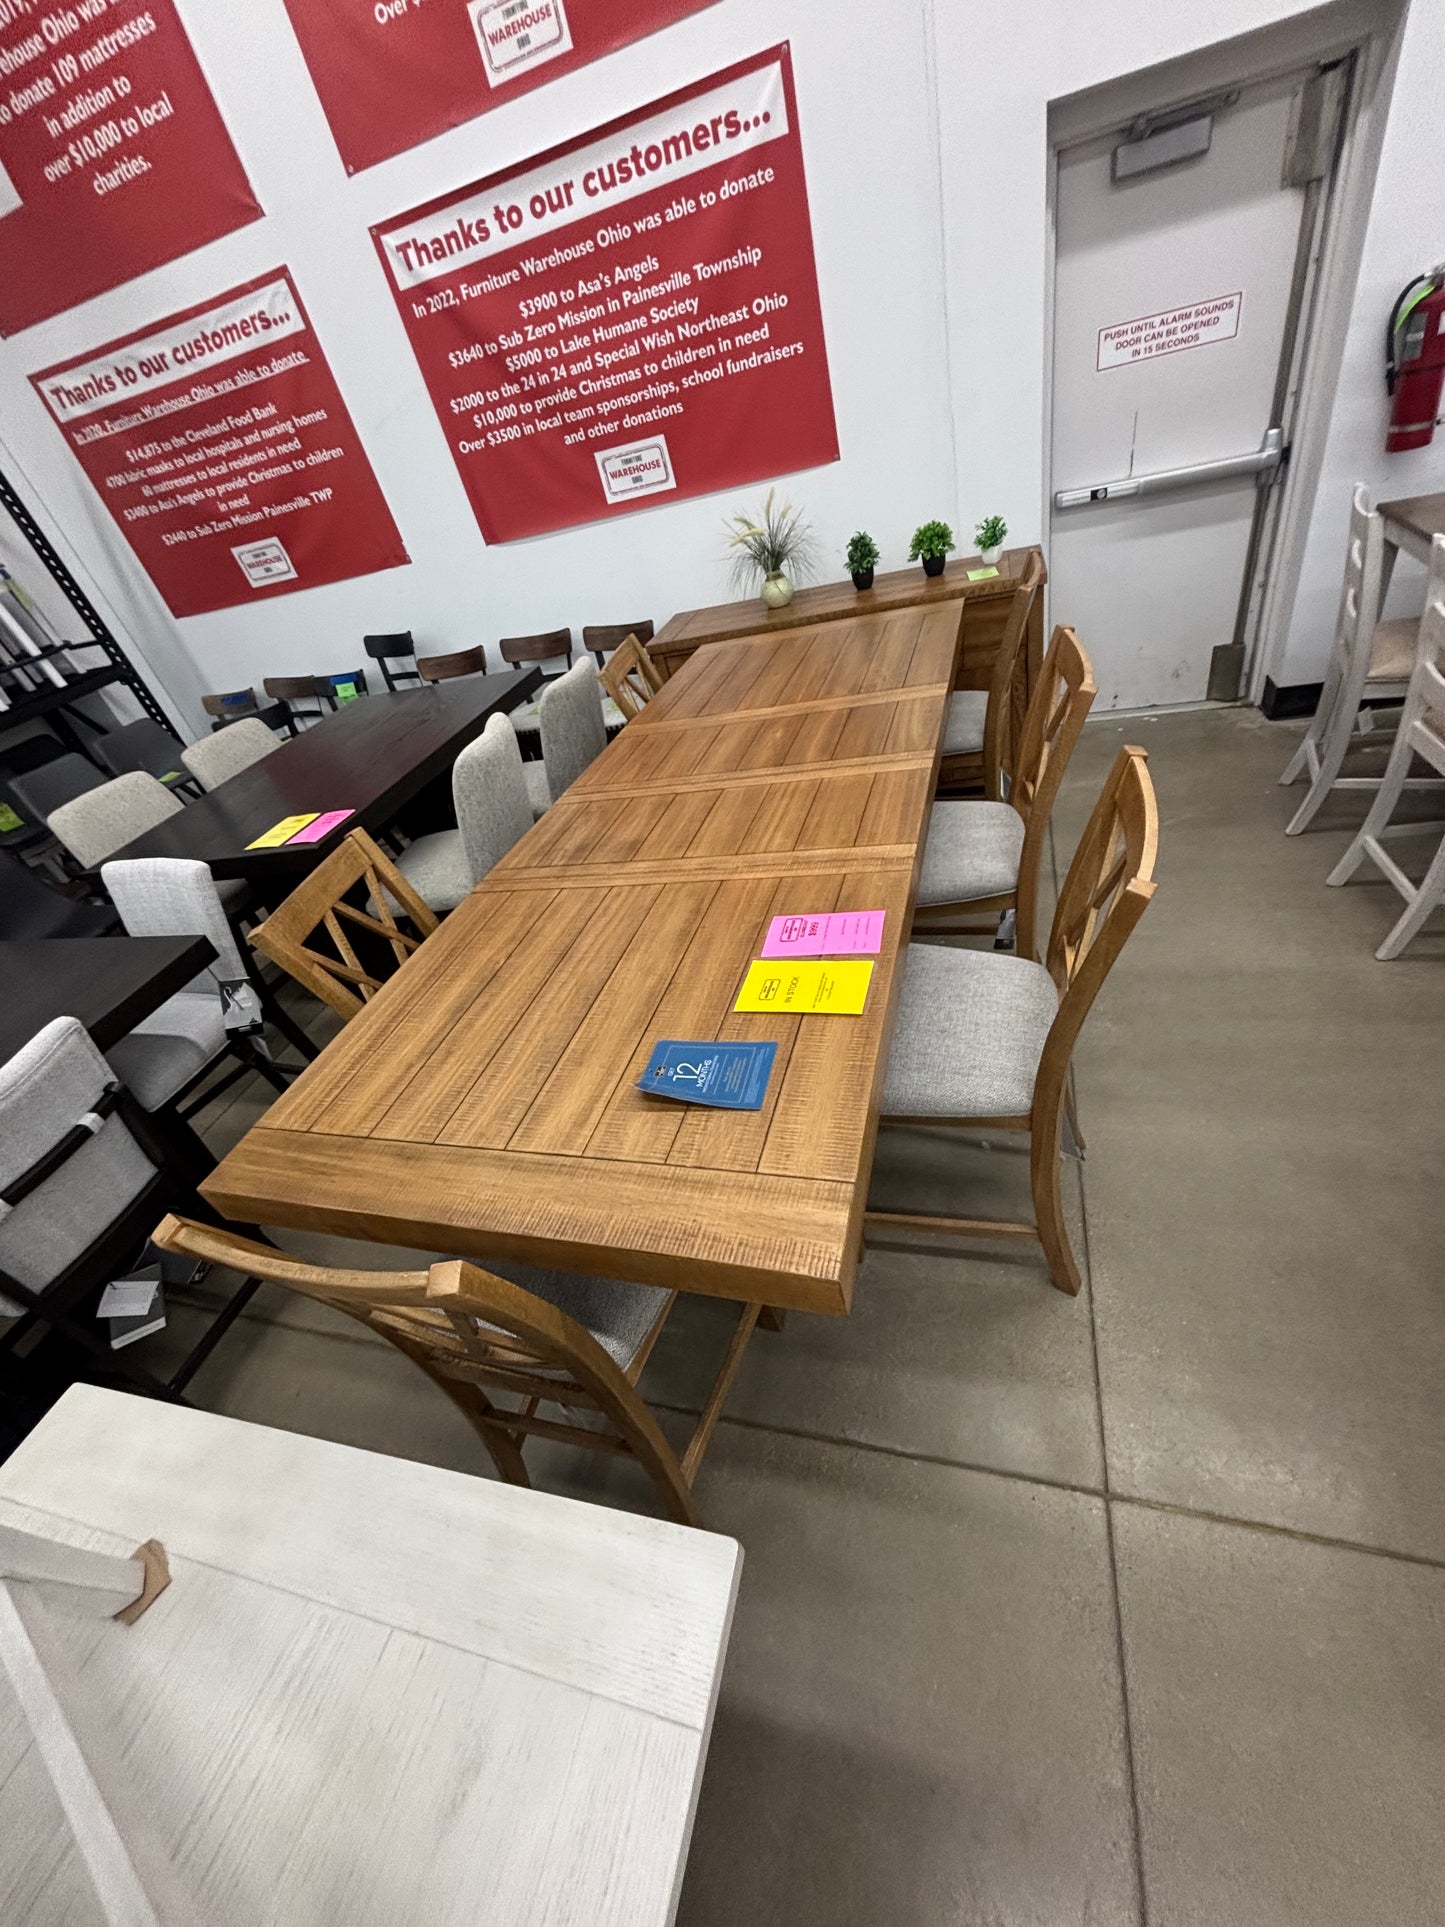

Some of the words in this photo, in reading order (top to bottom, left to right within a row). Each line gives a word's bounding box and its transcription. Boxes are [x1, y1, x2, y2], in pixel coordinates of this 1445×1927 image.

[0, 33, 47, 80] ehouse
[41, 8, 80, 45] Ohio
[488, 3, 552, 47] WAREHOUSE
[9, 77, 56, 115] donate
[51, 53, 80, 88] 109
[79, 11, 157, 72] mattresses
[42, 115, 63, 138] in
[60, 88, 116, 130] addition
[112, 75, 131, 97] to
[44, 154, 73, 182] over
[68, 120, 122, 168] $10,000
[119, 116, 139, 137] to
[134, 90, 175, 128] local
[93, 155, 152, 196] charities.
[395, 219, 490, 272] Thanks
[493, 205, 523, 233] to
[530, 180, 573, 219] our
[583, 111, 770, 197] customers...
[412, 304, 427, 318] In
[426, 289, 459, 313] 2022,
[460, 270, 520, 300] Furniture
[520, 240, 594, 276] Warehouse
[597, 224, 631, 247] Ohio
[633, 213, 662, 233] was
[665, 197, 696, 222] able
[700, 192, 716, 208] to
[720, 168, 774, 200] donate
[449, 344, 483, 368] $3640
[485, 343, 497, 354] to
[499, 331, 523, 349] Sub
[524, 323, 556, 341] Zero
[558, 305, 605, 330] Mission
[607, 297, 620, 312] in
[622, 272, 691, 307] Painesville
[693, 246, 761, 280] Township
[519, 291, 557, 318] $3900
[560, 290, 574, 303] to
[615, 255, 659, 284] Angels
[506, 348, 542, 372] $5000
[544, 347, 558, 359] to
[560, 335, 591, 353] Lake
[593, 316, 647, 343] Humane
[650, 298, 698, 323] Society
[1104, 329, 1128, 341] PUSH
[1131, 322, 1156, 334] UNTIL
[1159, 311, 1192, 327] ALARM
[1195, 300, 1233, 318] SOUNDS
[1116, 337, 1141, 350] DOOR
[1144, 332, 1163, 342] CAN
[1166, 327, 1177, 337] BE
[1181, 316, 1219, 333] OPENED
[1132, 349, 1140, 357] IN
[1144, 346, 1152, 354] 15
[1156, 333, 1199, 351] SECONDS
[50, 374, 116, 409] Thanks
[114, 366, 137, 386] to
[138, 353, 169, 378] our
[172, 311, 289, 365] customers...
[191, 384, 217, 403] Ohio
[214, 379, 238, 394] was
[235, 369, 259, 387] able
[257, 366, 272, 379] to
[271, 352, 308, 374] donate
[450, 392, 484, 414] $2000
[486, 391, 499, 402] to
[501, 383, 520, 397] the
[521, 374, 536, 390] 24
[537, 372, 550, 385] in
[551, 364, 567, 381] 24
[570, 356, 592, 375] and
[595, 340, 640, 369] Special
[641, 330, 675, 351] Wish
[677, 306, 749, 340] Northeast
[753, 293, 787, 315] Ohio
[474, 404, 517, 428] $10,000
[520, 403, 532, 414] to
[535, 387, 577, 413] provide
[579, 368, 641, 395] Christmas
[644, 363, 658, 375] to
[662, 345, 715, 370] children
[718, 338, 731, 352] in
[735, 323, 769, 347] need
[161, 442, 172, 451] to
[171, 436, 187, 448] the
[186, 419, 229, 442] Cleveland
[227, 411, 253, 428] Food
[252, 403, 277, 420] Bank
[459, 439, 485, 453] Over
[487, 425, 521, 446] $3500
[522, 423, 534, 435] in
[535, 412, 562, 431] local
[564, 407, 594, 422] team
[597, 382, 679, 415] sponsorships,
[682, 363, 724, 388] school
[727, 342, 803, 374] fundraisers
[564, 428, 585, 445] and
[588, 421, 619, 437] other
[623, 403, 683, 428] donations
[146, 461, 174, 475] masks
[174, 458, 185, 468] to
[183, 448, 205, 464] local
[203, 437, 244, 457] hospitals
[243, 429, 261, 445] and
[261, 421, 295, 439] nursing
[292, 410, 327, 427] homes
[197, 471, 207, 480] to
[206, 461, 229, 477] local
[228, 452, 267, 470] residents
[266, 447, 277, 457] in
[277, 437, 301, 454] need
[609, 459, 661, 479] WAREHOUSE
[148, 505, 159, 513] to
[176, 489, 205, 505] Angels
[204, 488, 215, 497] to
[216, 476, 248, 496] provide
[248, 464, 292, 483] Christmas
[293, 460, 305, 469] to
[307, 448, 344, 465] children
[217, 502, 228, 512] in
[228, 494, 250, 509] need
[187, 531, 197, 539] to
[195, 525, 212, 536] Sub
[210, 521, 232, 532] Zero
[231, 512, 264, 526] Mission
[262, 496, 311, 517] Painesville
[310, 488, 332, 503] TWP
[786, 975, 799, 997] STOCK
[672, 1062, 703, 1082] 12
